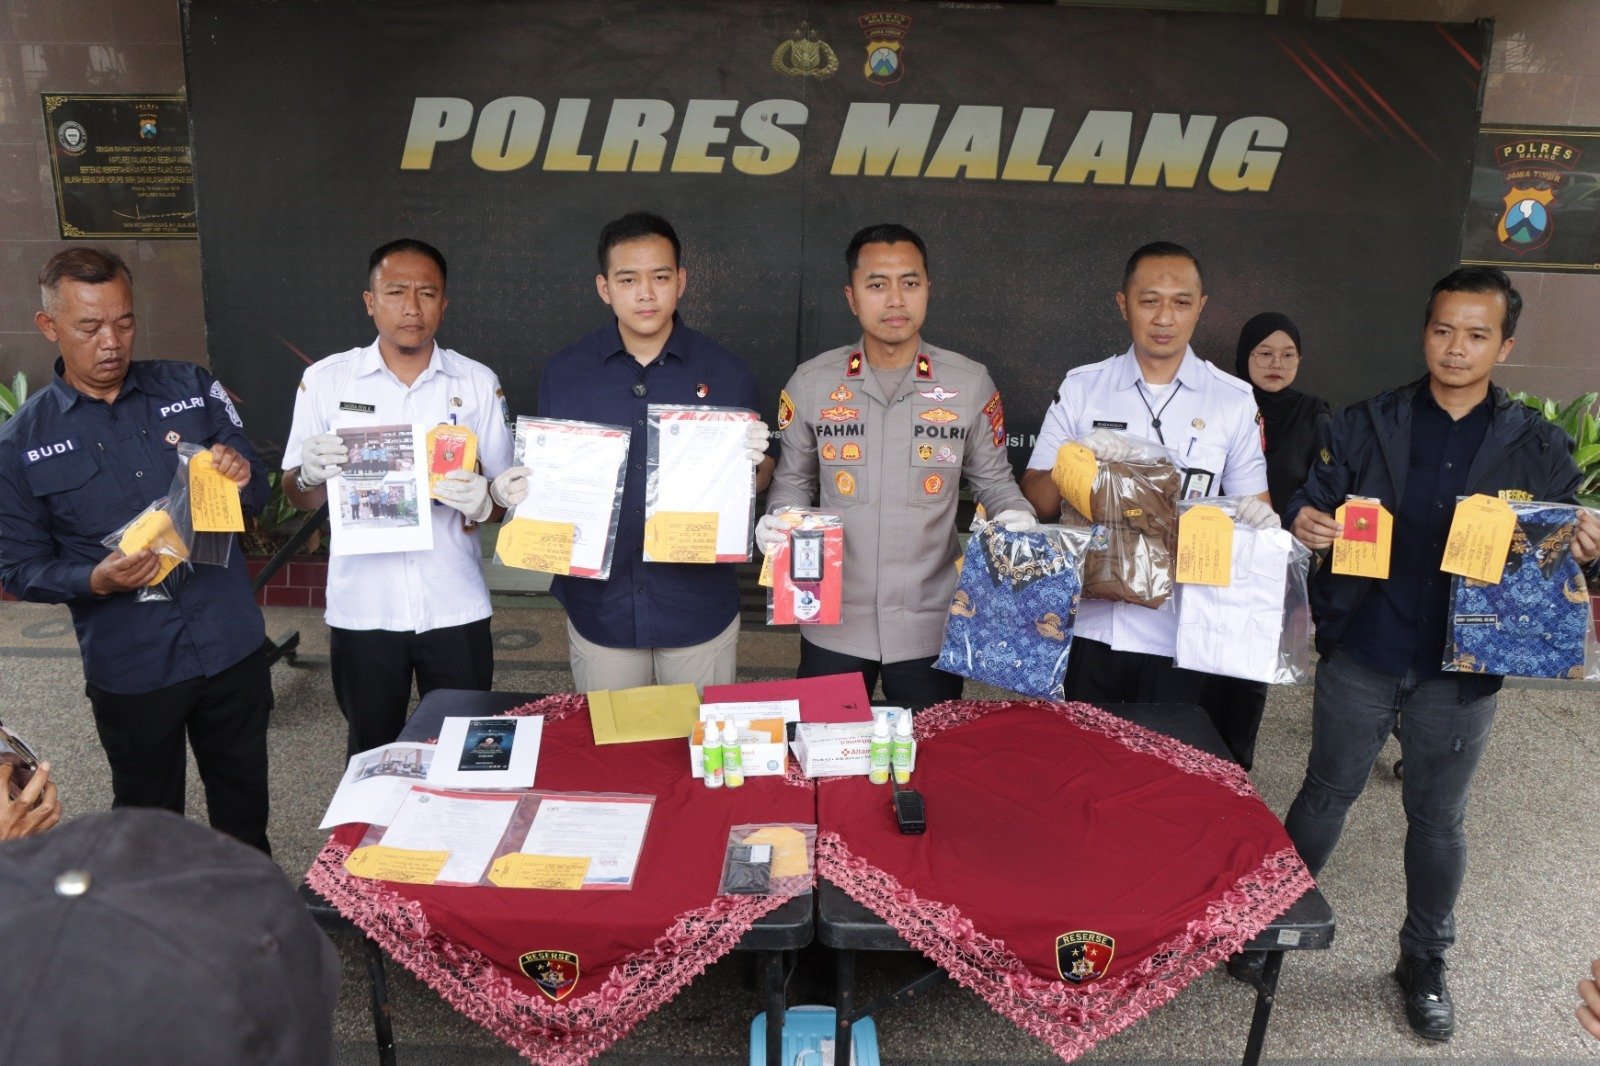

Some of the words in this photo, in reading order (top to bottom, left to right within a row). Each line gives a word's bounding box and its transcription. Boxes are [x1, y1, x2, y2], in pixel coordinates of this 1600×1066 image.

[400, 96, 809, 176] POLRES
[829, 102, 1290, 192] MALANG
[1503, 143, 1573, 160] POLRES
[1519, 152, 1556, 161] MALANG
[1506, 170, 1531, 180] JAWA
[1533, 170, 1560, 182] TIMUR
[160, 397, 205, 417] POLRI
[816, 424, 865, 437] FAHMI
[914, 425, 965, 440] POLRI
[27, 439, 73, 462] BUDI
[1063, 932, 1108, 945] RESERSE
[525, 952, 571, 961] RESERSE
